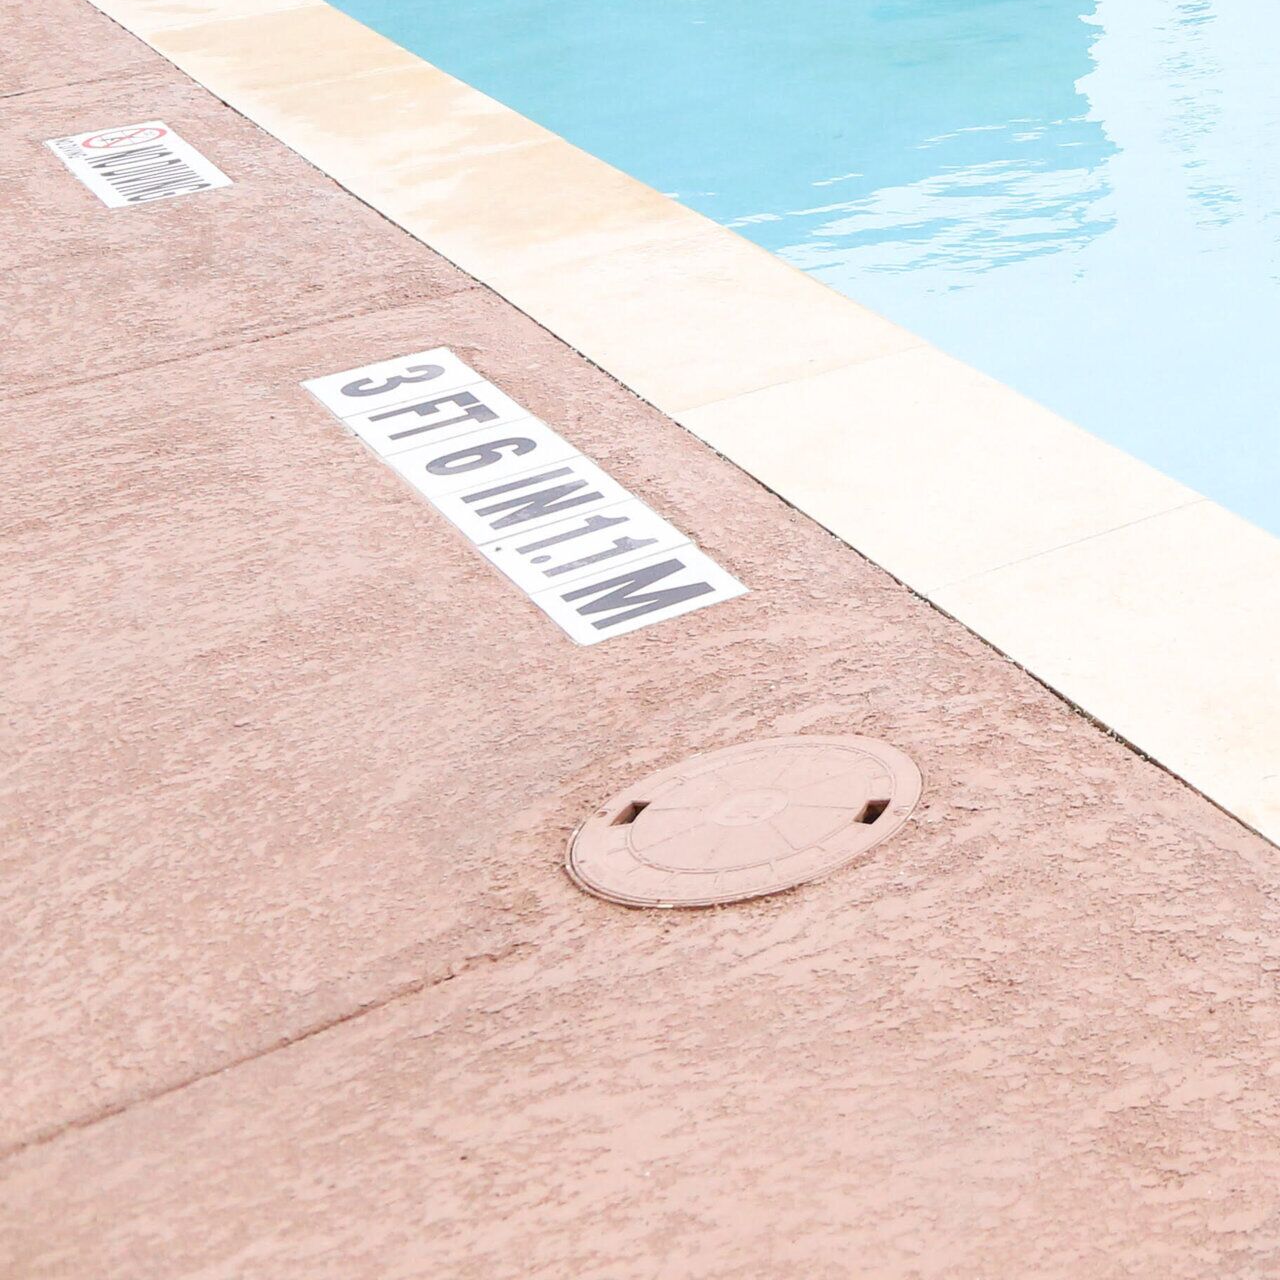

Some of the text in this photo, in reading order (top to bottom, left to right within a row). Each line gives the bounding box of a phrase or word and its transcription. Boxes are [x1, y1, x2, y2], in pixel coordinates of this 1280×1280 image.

[340, 363, 446, 398] 3
[367, 390, 501, 441] FT
[425, 436, 538, 477] 6
[559, 557, 717, 631] M
